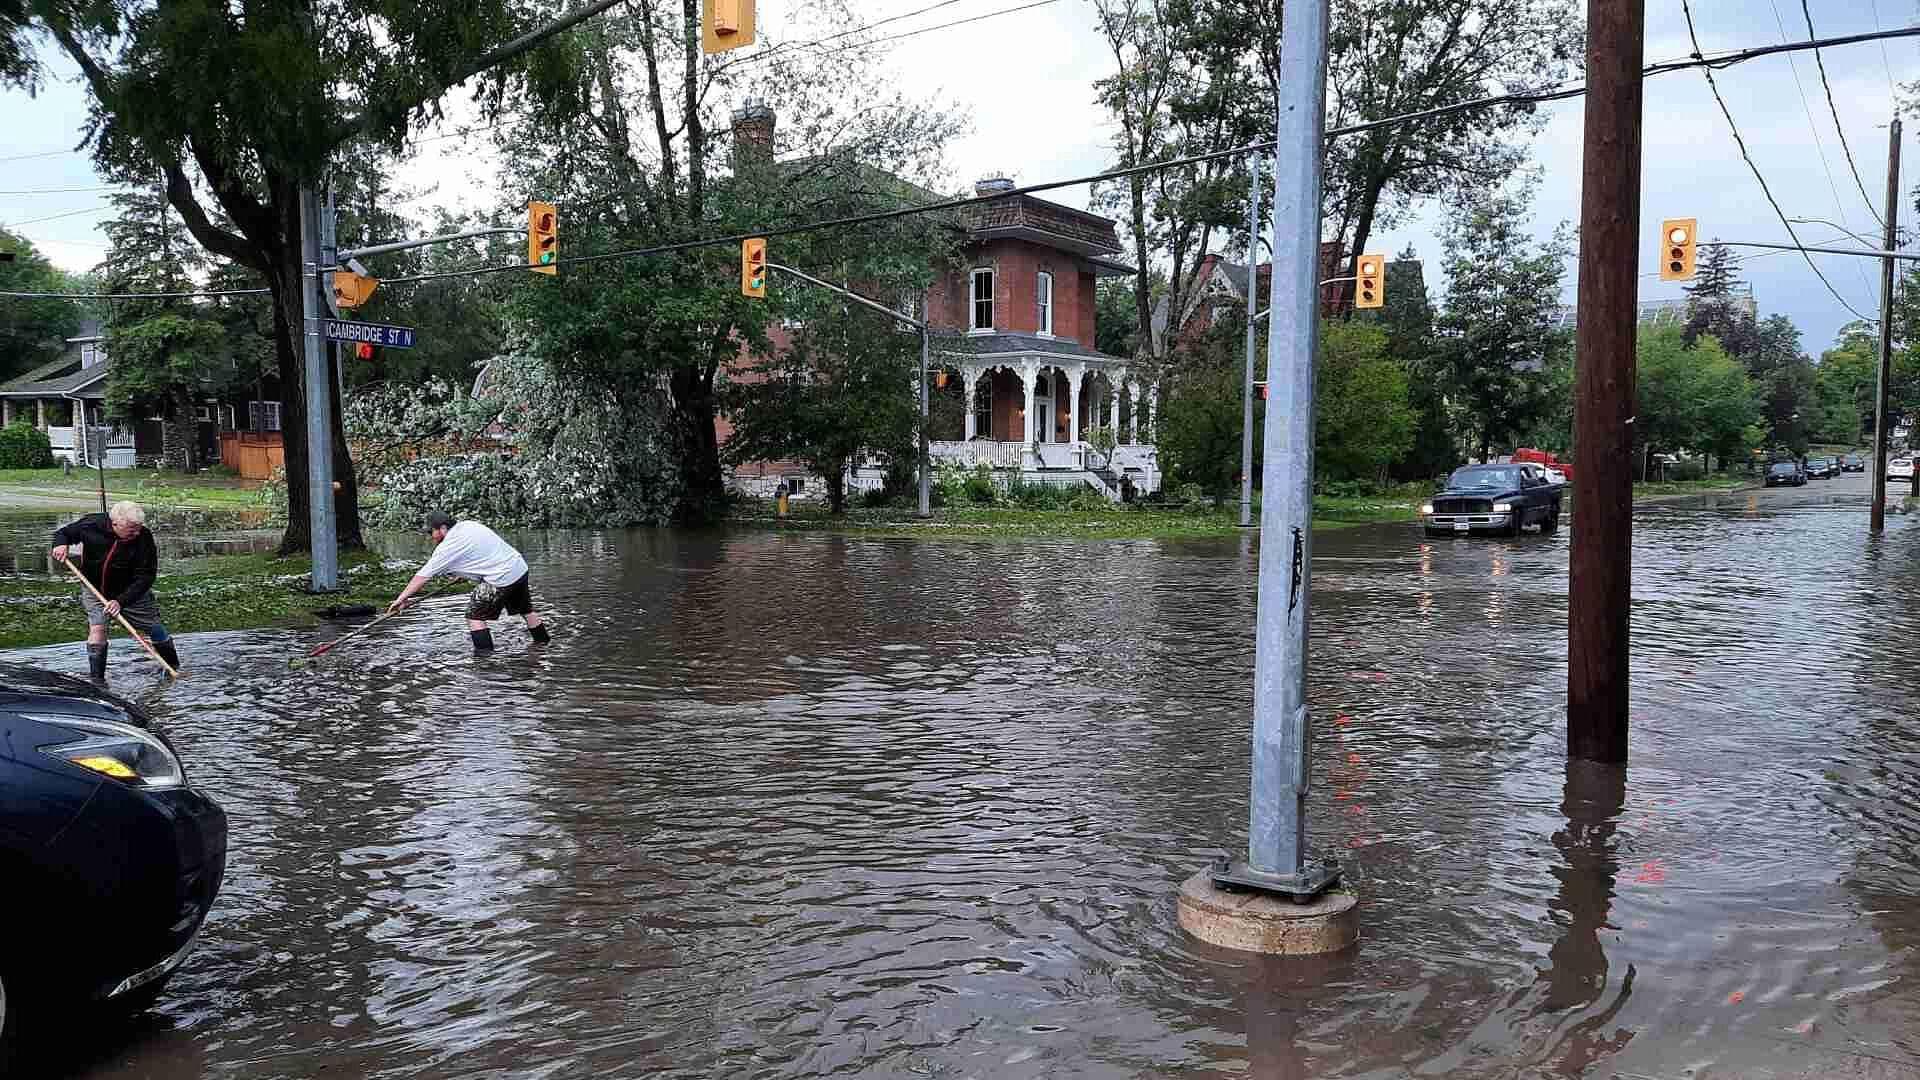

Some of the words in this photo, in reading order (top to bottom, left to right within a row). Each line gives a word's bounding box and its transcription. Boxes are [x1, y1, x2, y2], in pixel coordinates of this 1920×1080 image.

[328, 322, 383, 343] CAMBRIDGE
[388, 328, 400, 345] ST
[404, 330, 411, 346] N
